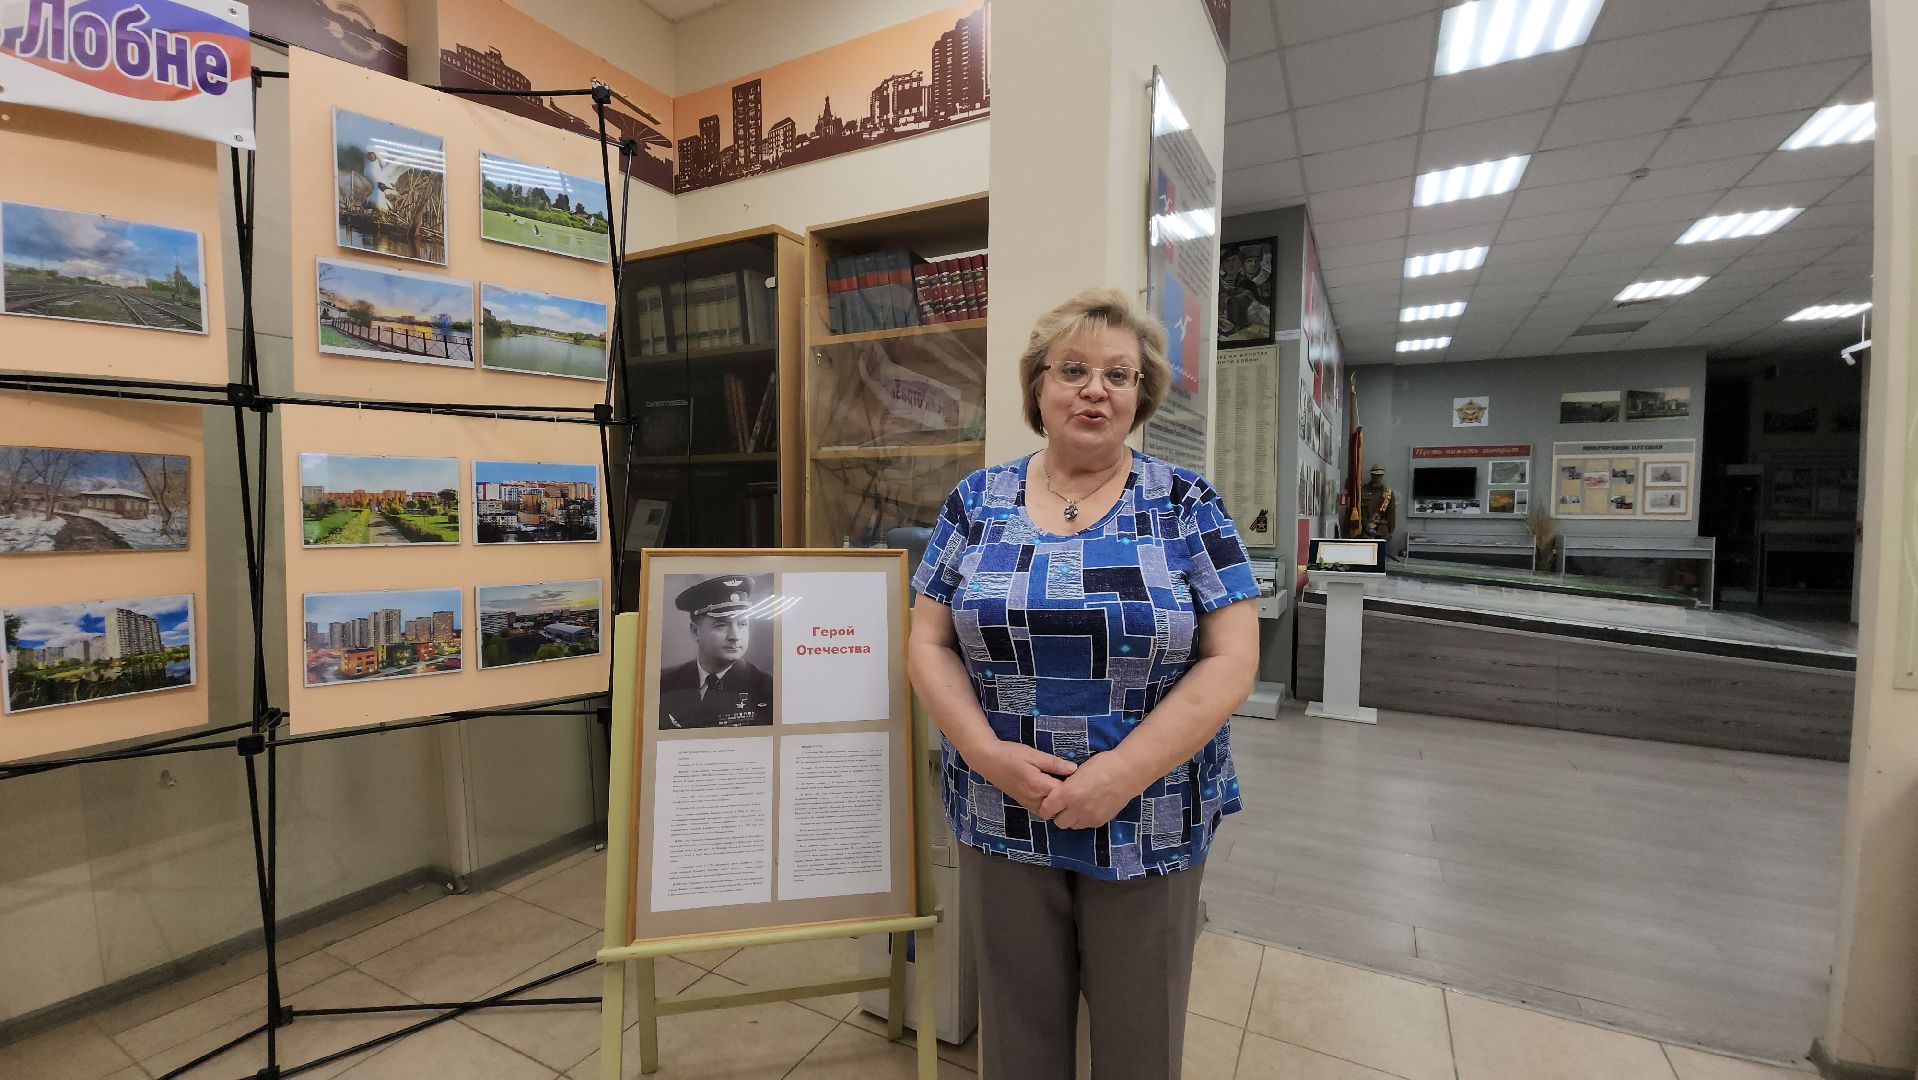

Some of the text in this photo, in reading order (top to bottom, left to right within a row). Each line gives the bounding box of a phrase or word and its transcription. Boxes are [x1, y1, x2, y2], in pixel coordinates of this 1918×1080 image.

[15, 0, 231, 97] Лобне
[1416, 448, 1442, 456] Пусть
[812, 626, 855, 639] Герой
[796, 644, 871, 656] Отечества
